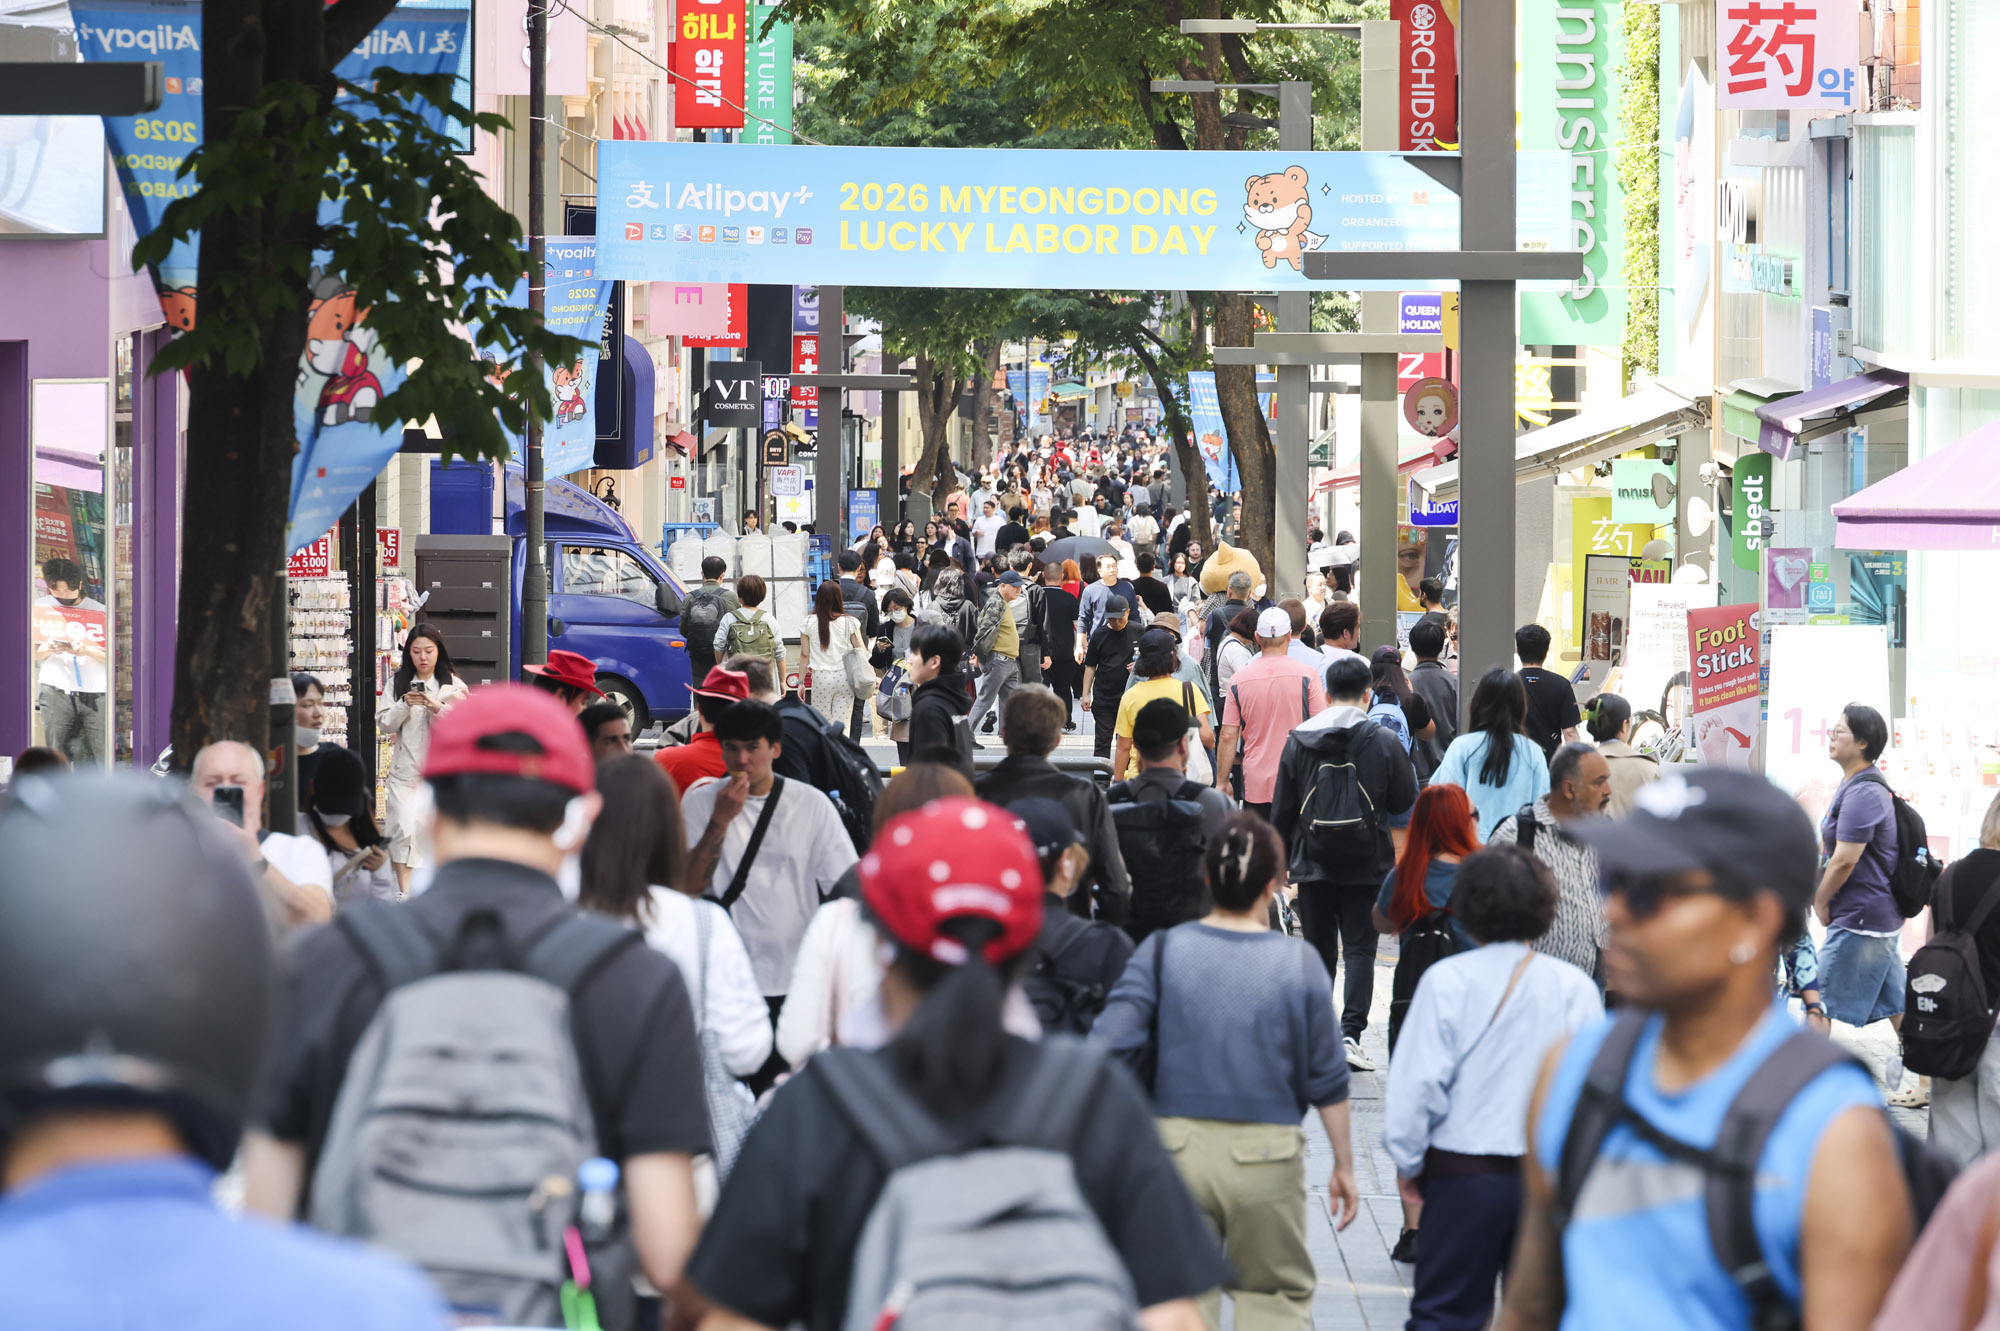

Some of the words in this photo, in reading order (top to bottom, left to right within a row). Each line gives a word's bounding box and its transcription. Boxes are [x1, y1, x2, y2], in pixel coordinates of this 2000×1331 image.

[682, 12, 737, 40] 하나
[1727, 2, 1817, 97] 药
[1818, 68, 1855, 106] 약
[757, 118, 775, 145] RE
[625, 180, 659, 209] 支
[676, 181, 814, 219] Alipay+
[839, 182, 929, 213] 2026
[939, 184, 1218, 217] MYEONGDONG
[1340, 193, 1384, 204] HOSTED
[1340, 216, 1403, 228] ORGANIZED
[797, 233, 810, 243] Pay
[839, 219, 974, 253] LUCKY
[985, 222, 1119, 255] LABOR
[1130, 224, 1217, 256] DAY
[1340, 239, 1403, 251] SUPPORTED
[1531, 241, 1547, 250] pay
[1404, 305, 1440, 316] QUEEN
[801, 339, 816, 355] 藥
[761, 377, 790, 398] HOP
[714, 402, 756, 410] COSMETICS
[791, 399, 806, 407] Drug
[1412, 502, 1458, 515] HLIDAY
[1592, 516, 1633, 556] 药
[296, 541, 327, 556] ALE
[1891, 561, 1903, 576] 3
[1596, 576, 1618, 585] HAIR
[1657, 600, 1687, 609] Reveal
[1635, 610, 1667, 619] Firmness
[1676, 611, 1686, 619] Ra
[1662, 621, 1671, 629] 28
[1672, 621, 1688, 631] Day
[1695, 618, 1748, 653] Foot
[1696, 643, 1755, 679] Stick
[1698, 686, 1714, 695] Makes
[1714, 683, 1723, 692] you
[1723, 678, 1737, 688] rough
[1705, 695, 1720, 704] turns
[1720, 690, 1736, 700] clean
[1736, 685, 1747, 696] like
[1748, 683, 1757, 692] the
[1783, 707, 1829, 755] 1+
